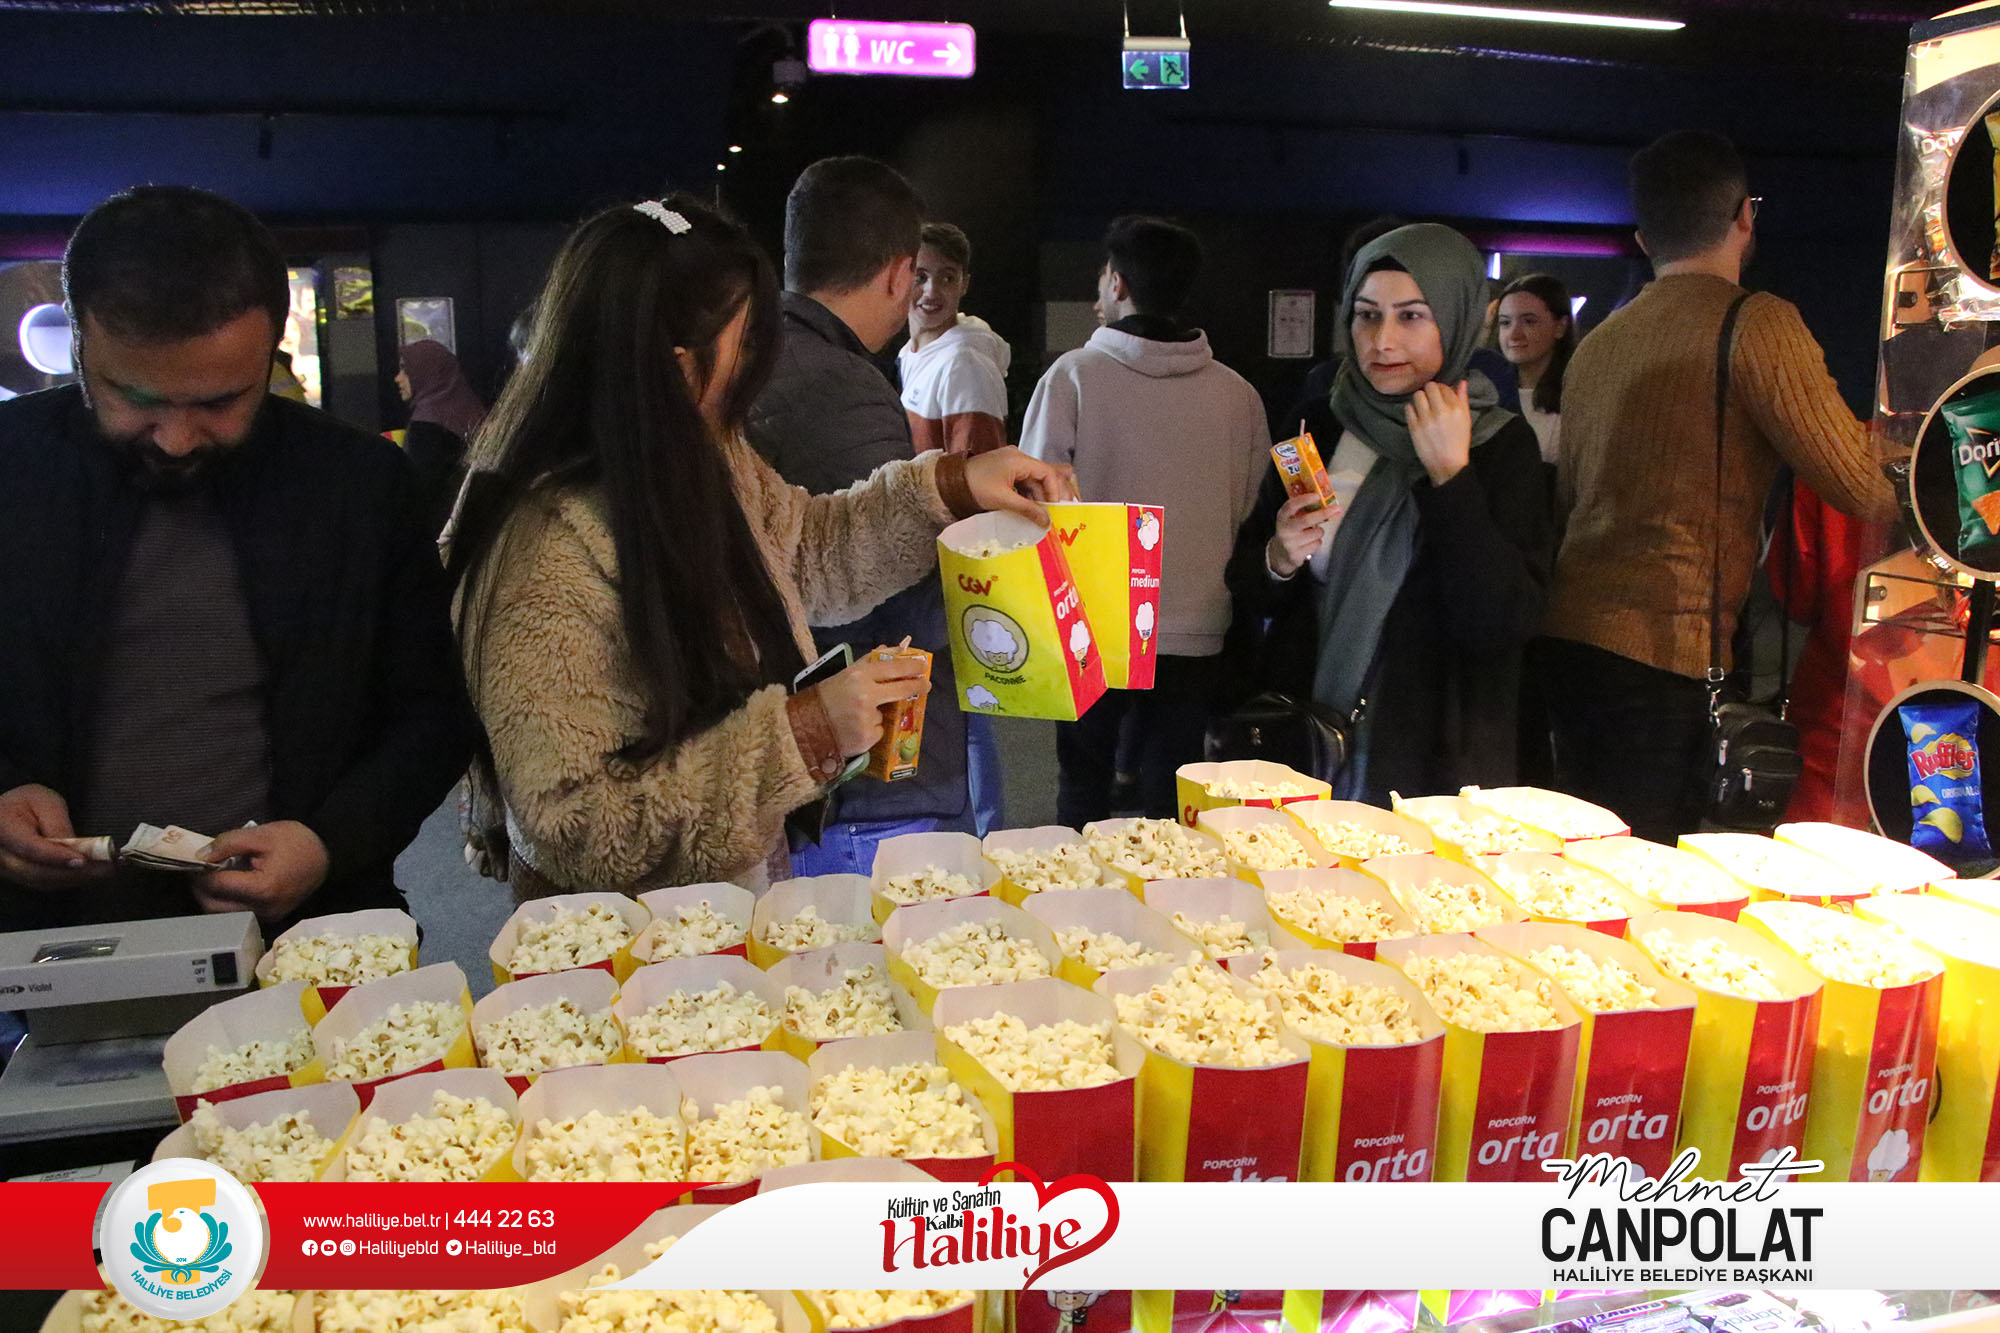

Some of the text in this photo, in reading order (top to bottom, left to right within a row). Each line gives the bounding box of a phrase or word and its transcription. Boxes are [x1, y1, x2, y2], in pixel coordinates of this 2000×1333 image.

[870, 40, 915, 65] WC
[1130, 574, 1160, 588] medium
[1909, 741, 1977, 780] Ruffles
[1597, 1094, 1643, 1107] POPCORN
[1869, 1077, 1928, 1114] orta
[1488, 1115, 1537, 1129] POPCORN
[1587, 1109, 1669, 1144] orta
[1746, 1093, 1808, 1131] orta
[1354, 1133, 1405, 1148] POPCORN
[1478, 1130, 1559, 1166] orta
[1203, 1157, 1258, 1169] POPCORN
[1345, 1149, 1428, 1182] orta
